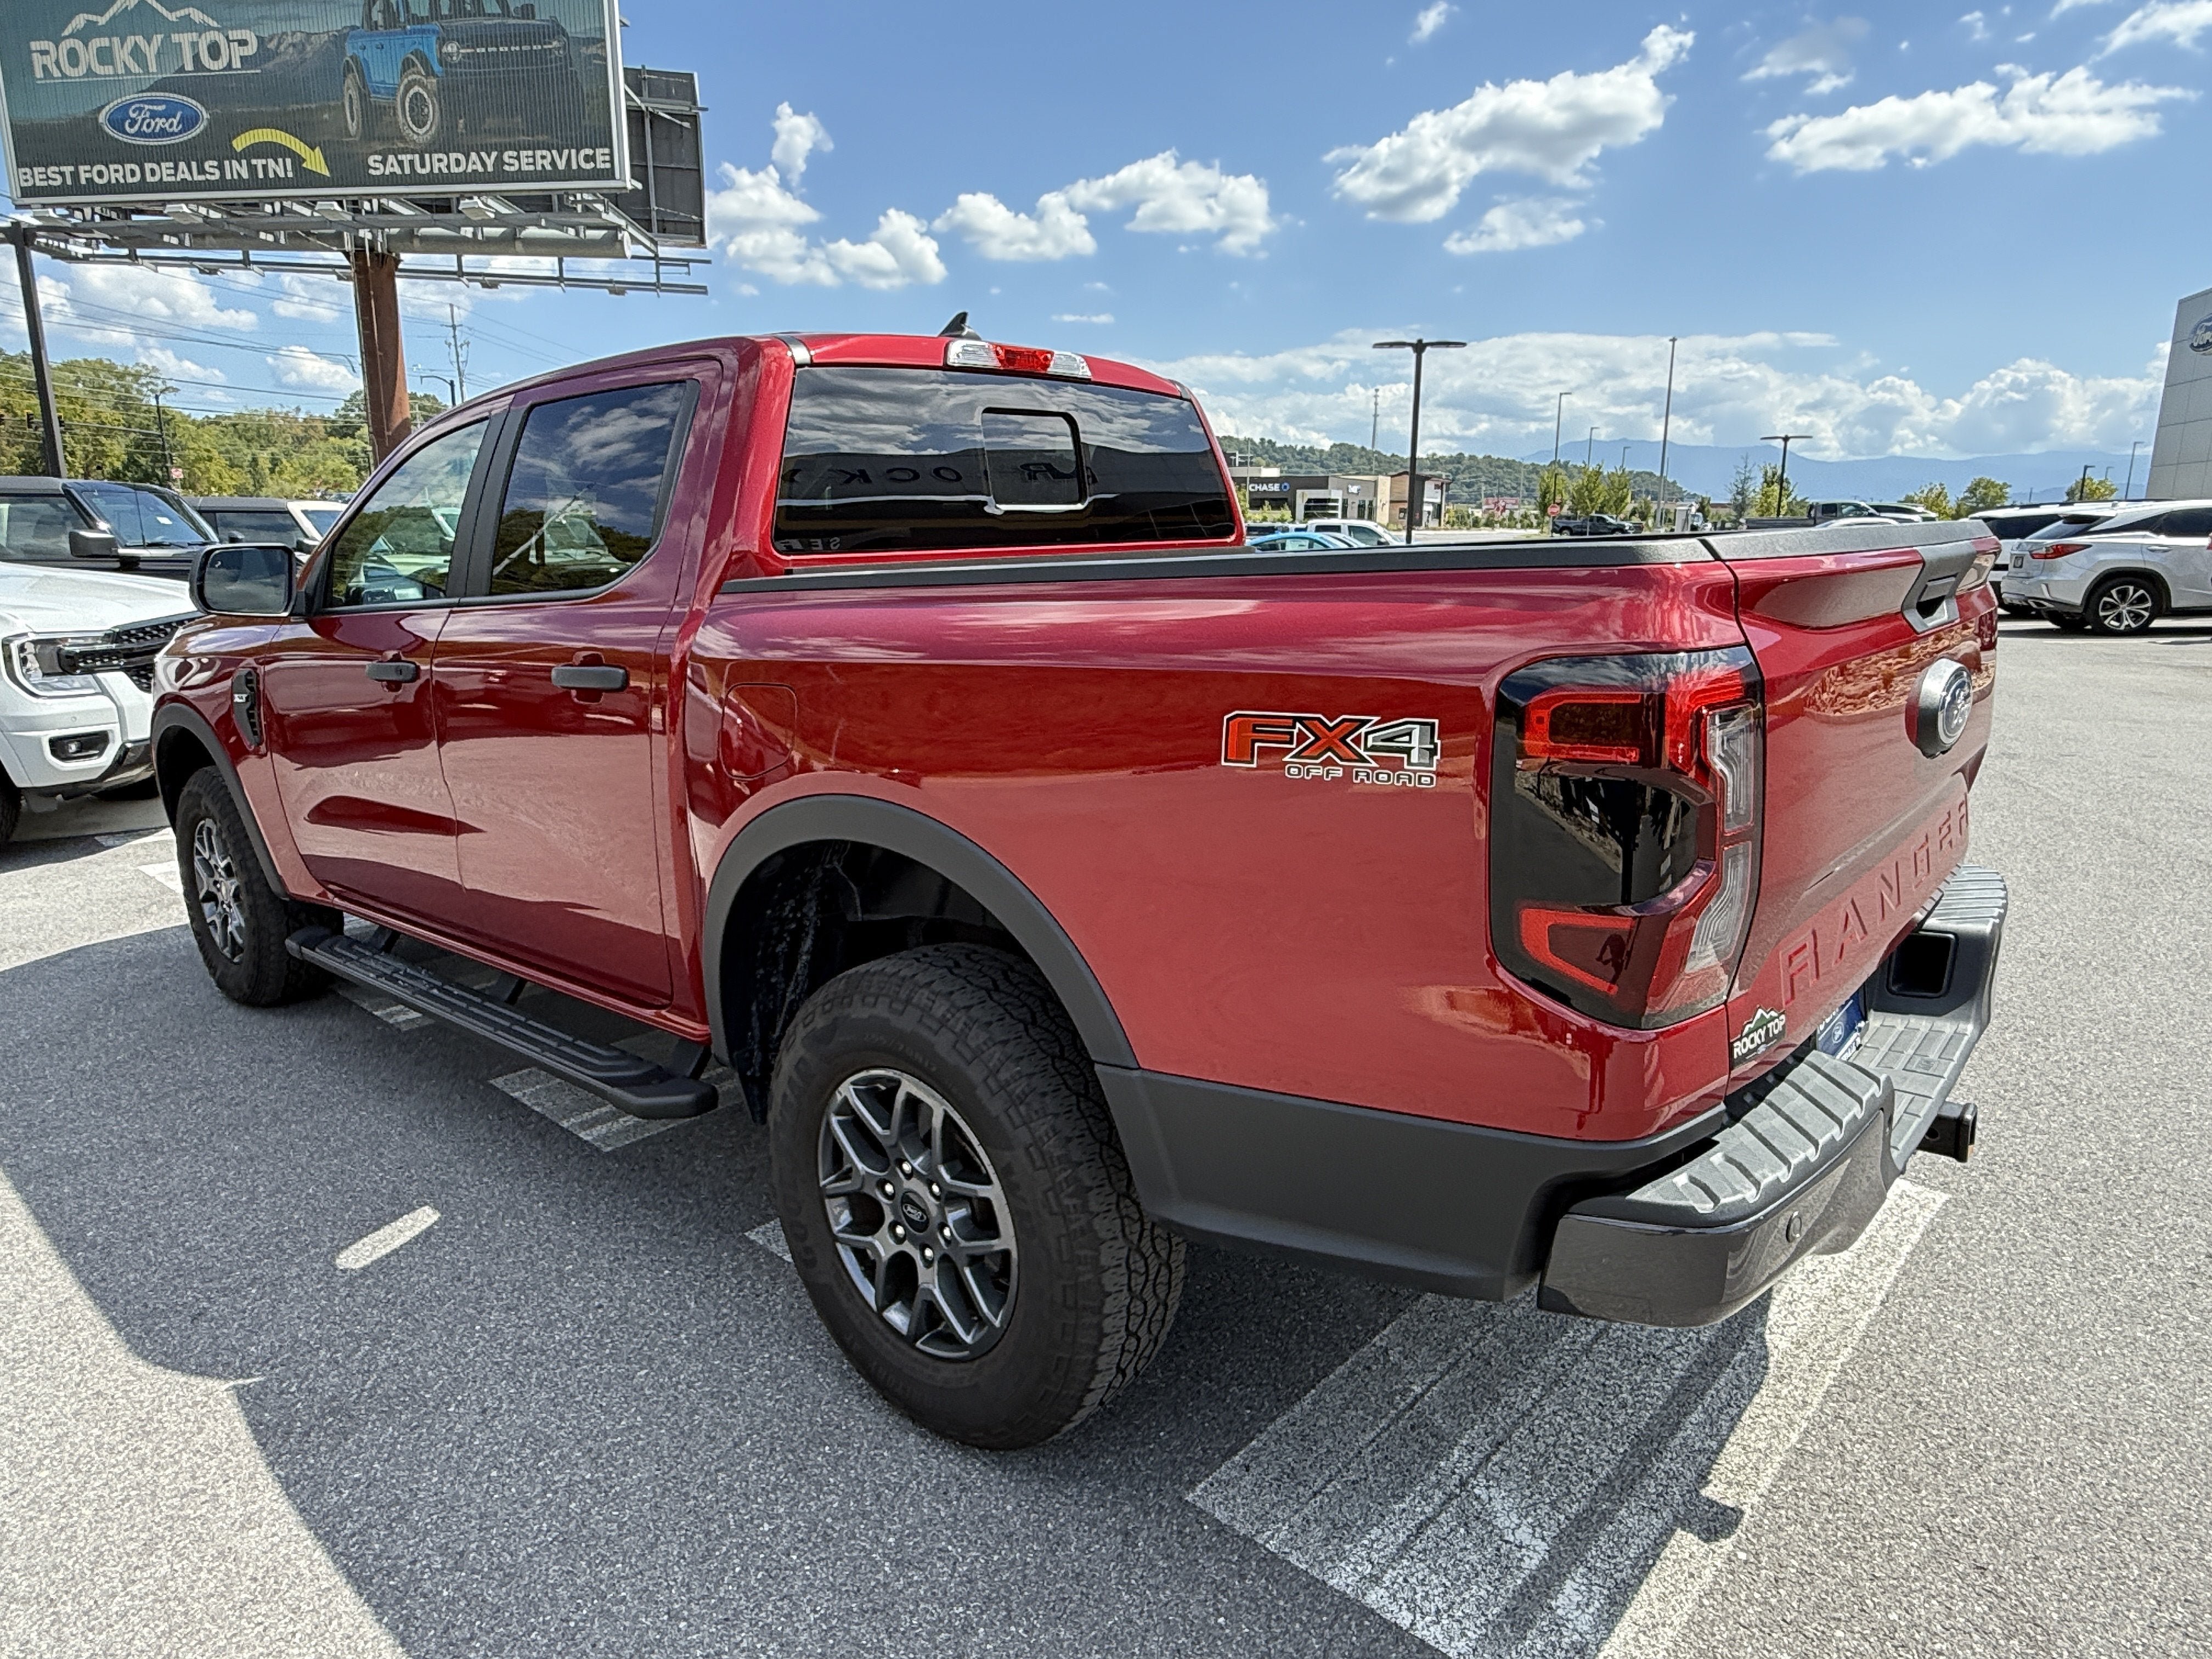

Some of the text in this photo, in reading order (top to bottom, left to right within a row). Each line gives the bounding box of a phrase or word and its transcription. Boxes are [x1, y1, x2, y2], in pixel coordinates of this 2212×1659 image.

[30, 29, 258, 78] ROCKY TOP
[125, 103, 183, 134] Ford
[18, 157, 294, 187] BEST FORD DEALS IN TN!
[367, 148, 612, 176] SATURDAY SERVICE
[1249, 483, 1280, 492] CHASE
[1221, 710, 1441, 771] FX4
[1285, 764, 1437, 788] OFF ROAD
[1779, 792, 1968, 1007] RANGER
[1734, 1025, 1767, 1059] ROCKY
[1767, 1013, 1786, 1038] TOP
